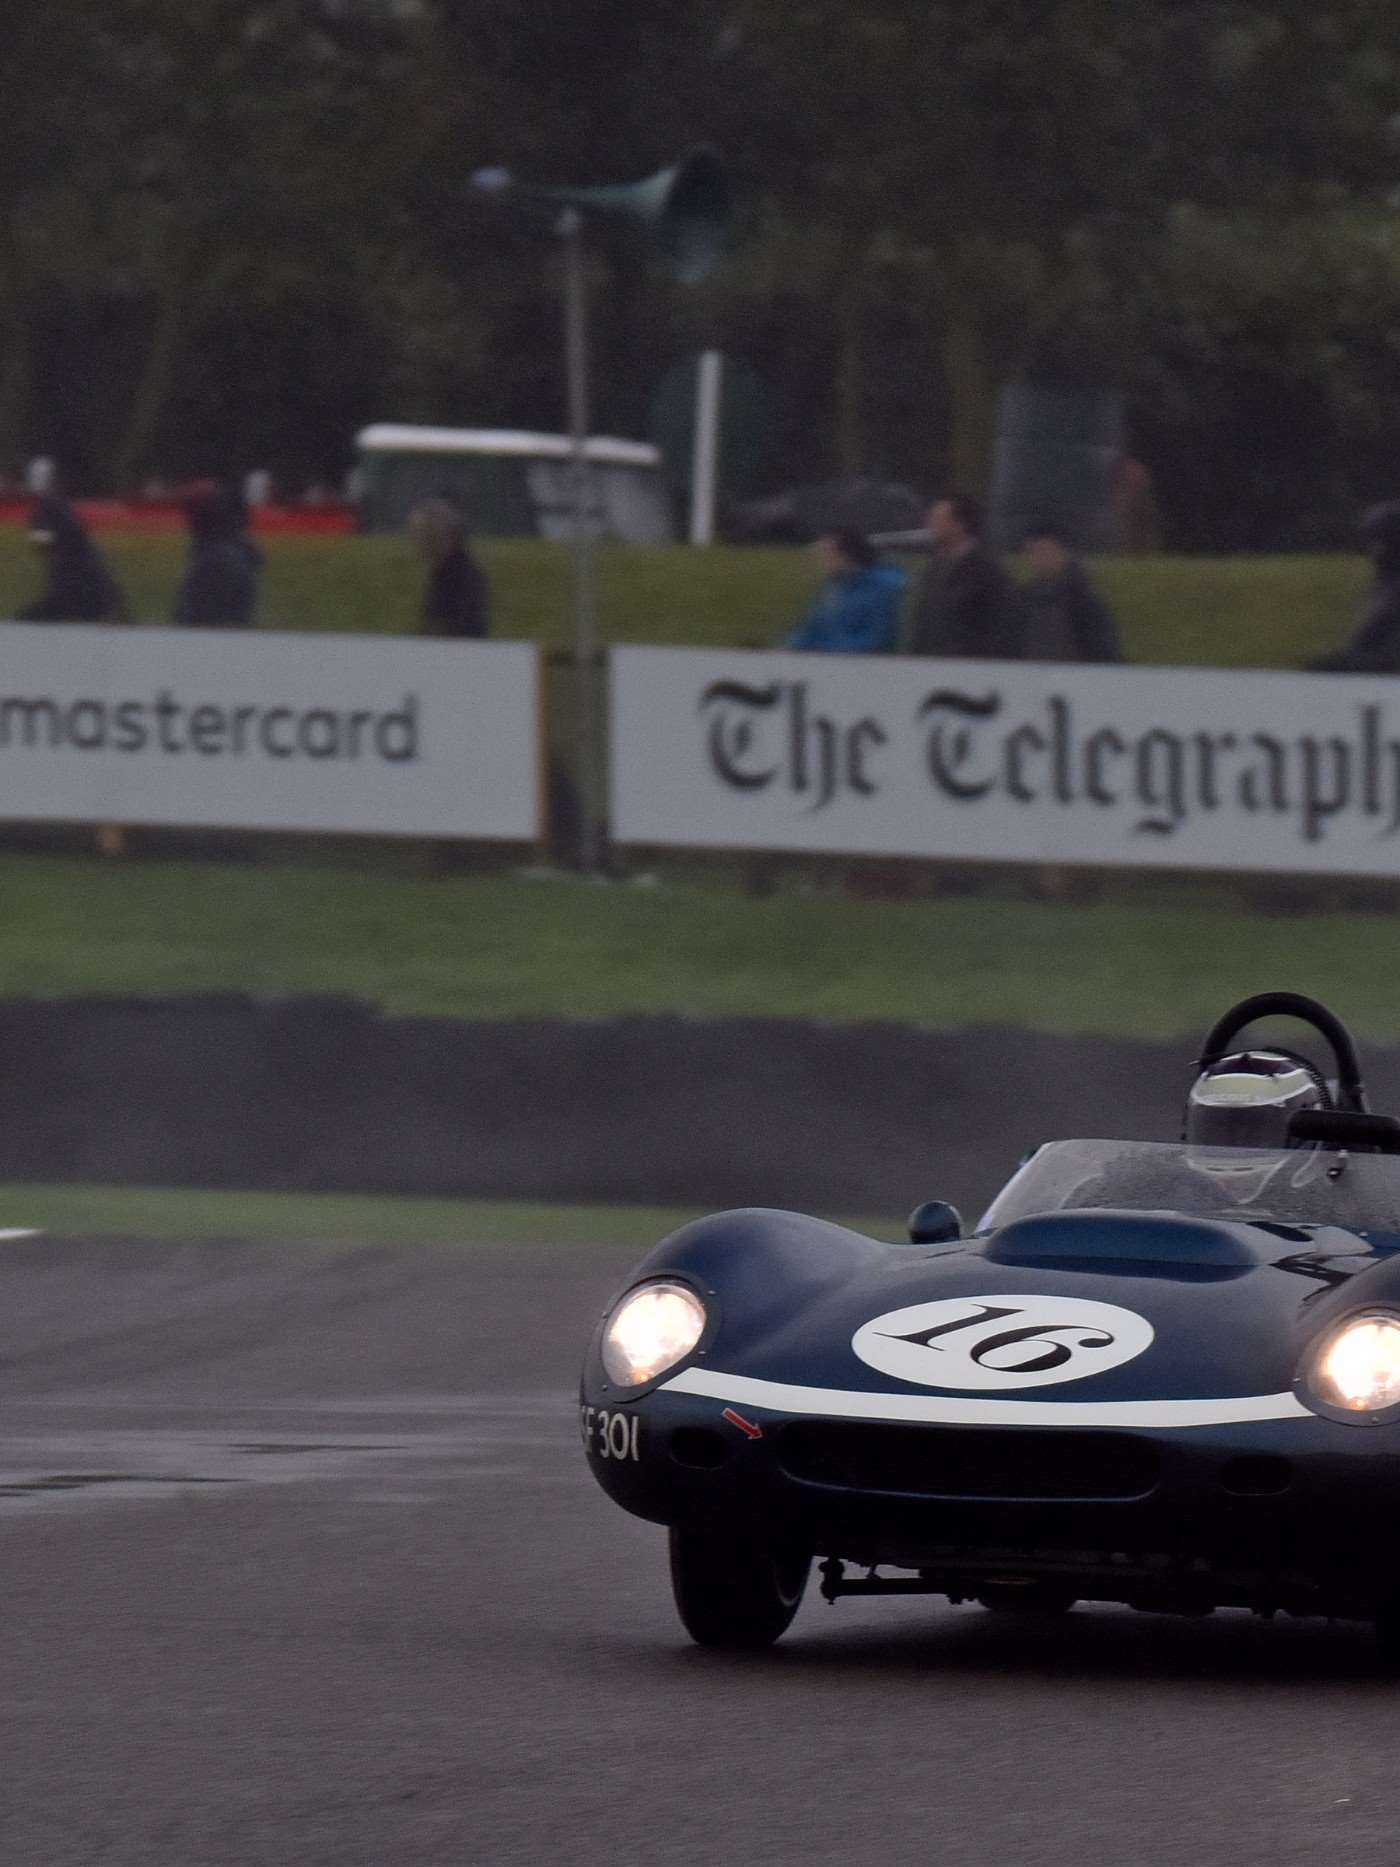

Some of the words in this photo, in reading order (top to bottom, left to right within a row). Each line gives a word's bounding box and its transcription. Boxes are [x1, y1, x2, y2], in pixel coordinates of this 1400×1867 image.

[0, 690, 420, 763] mastercard
[699, 675, 888, 815] The
[872, 1303, 1115, 1374] 16
[598, 1409, 641, 1462] 301
